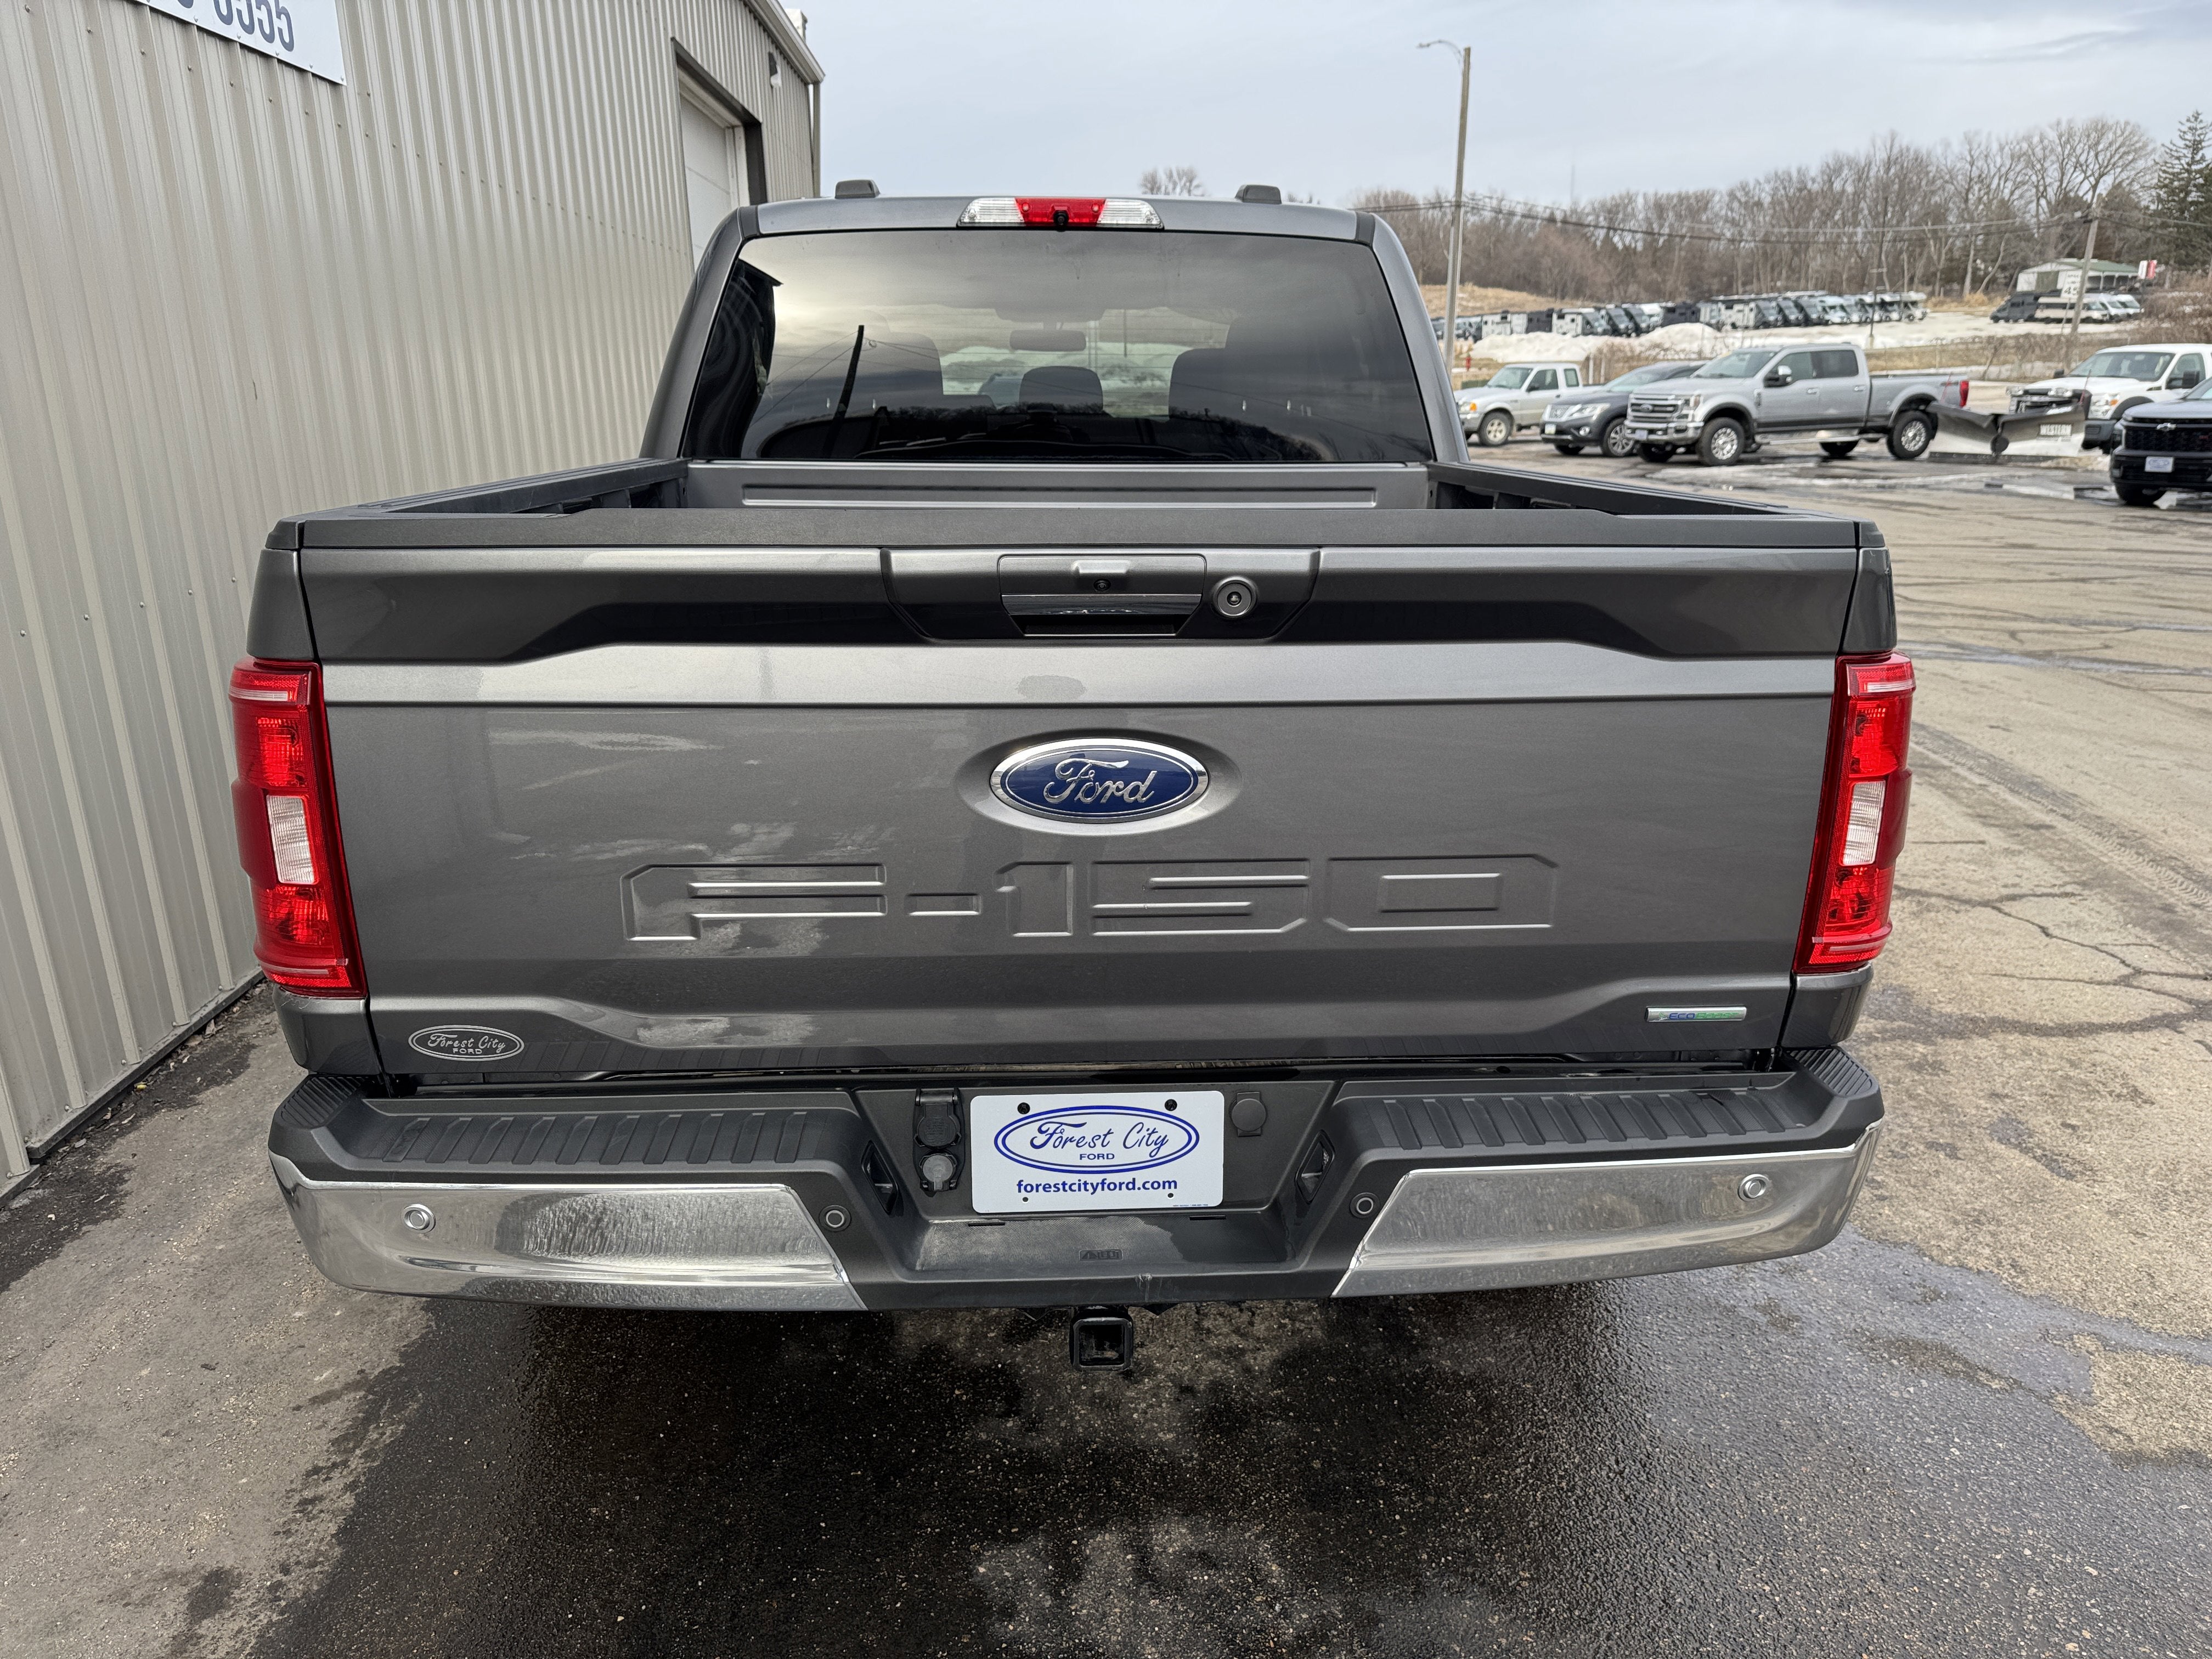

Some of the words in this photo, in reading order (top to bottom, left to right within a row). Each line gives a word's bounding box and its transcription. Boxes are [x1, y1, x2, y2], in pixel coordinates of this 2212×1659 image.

[1043, 758, 1158, 804] Ford
[620, 855, 1559, 941] F-150
[427, 1033, 475, 1048] Forest
[478, 1035, 506, 1053] City
[1030, 1121, 1115, 1150] Forest
[1122, 1122, 1171, 1158] City
[1079, 1153, 1115, 1161] FORD
[1017, 1178, 1178, 1195] forestcityford.com
